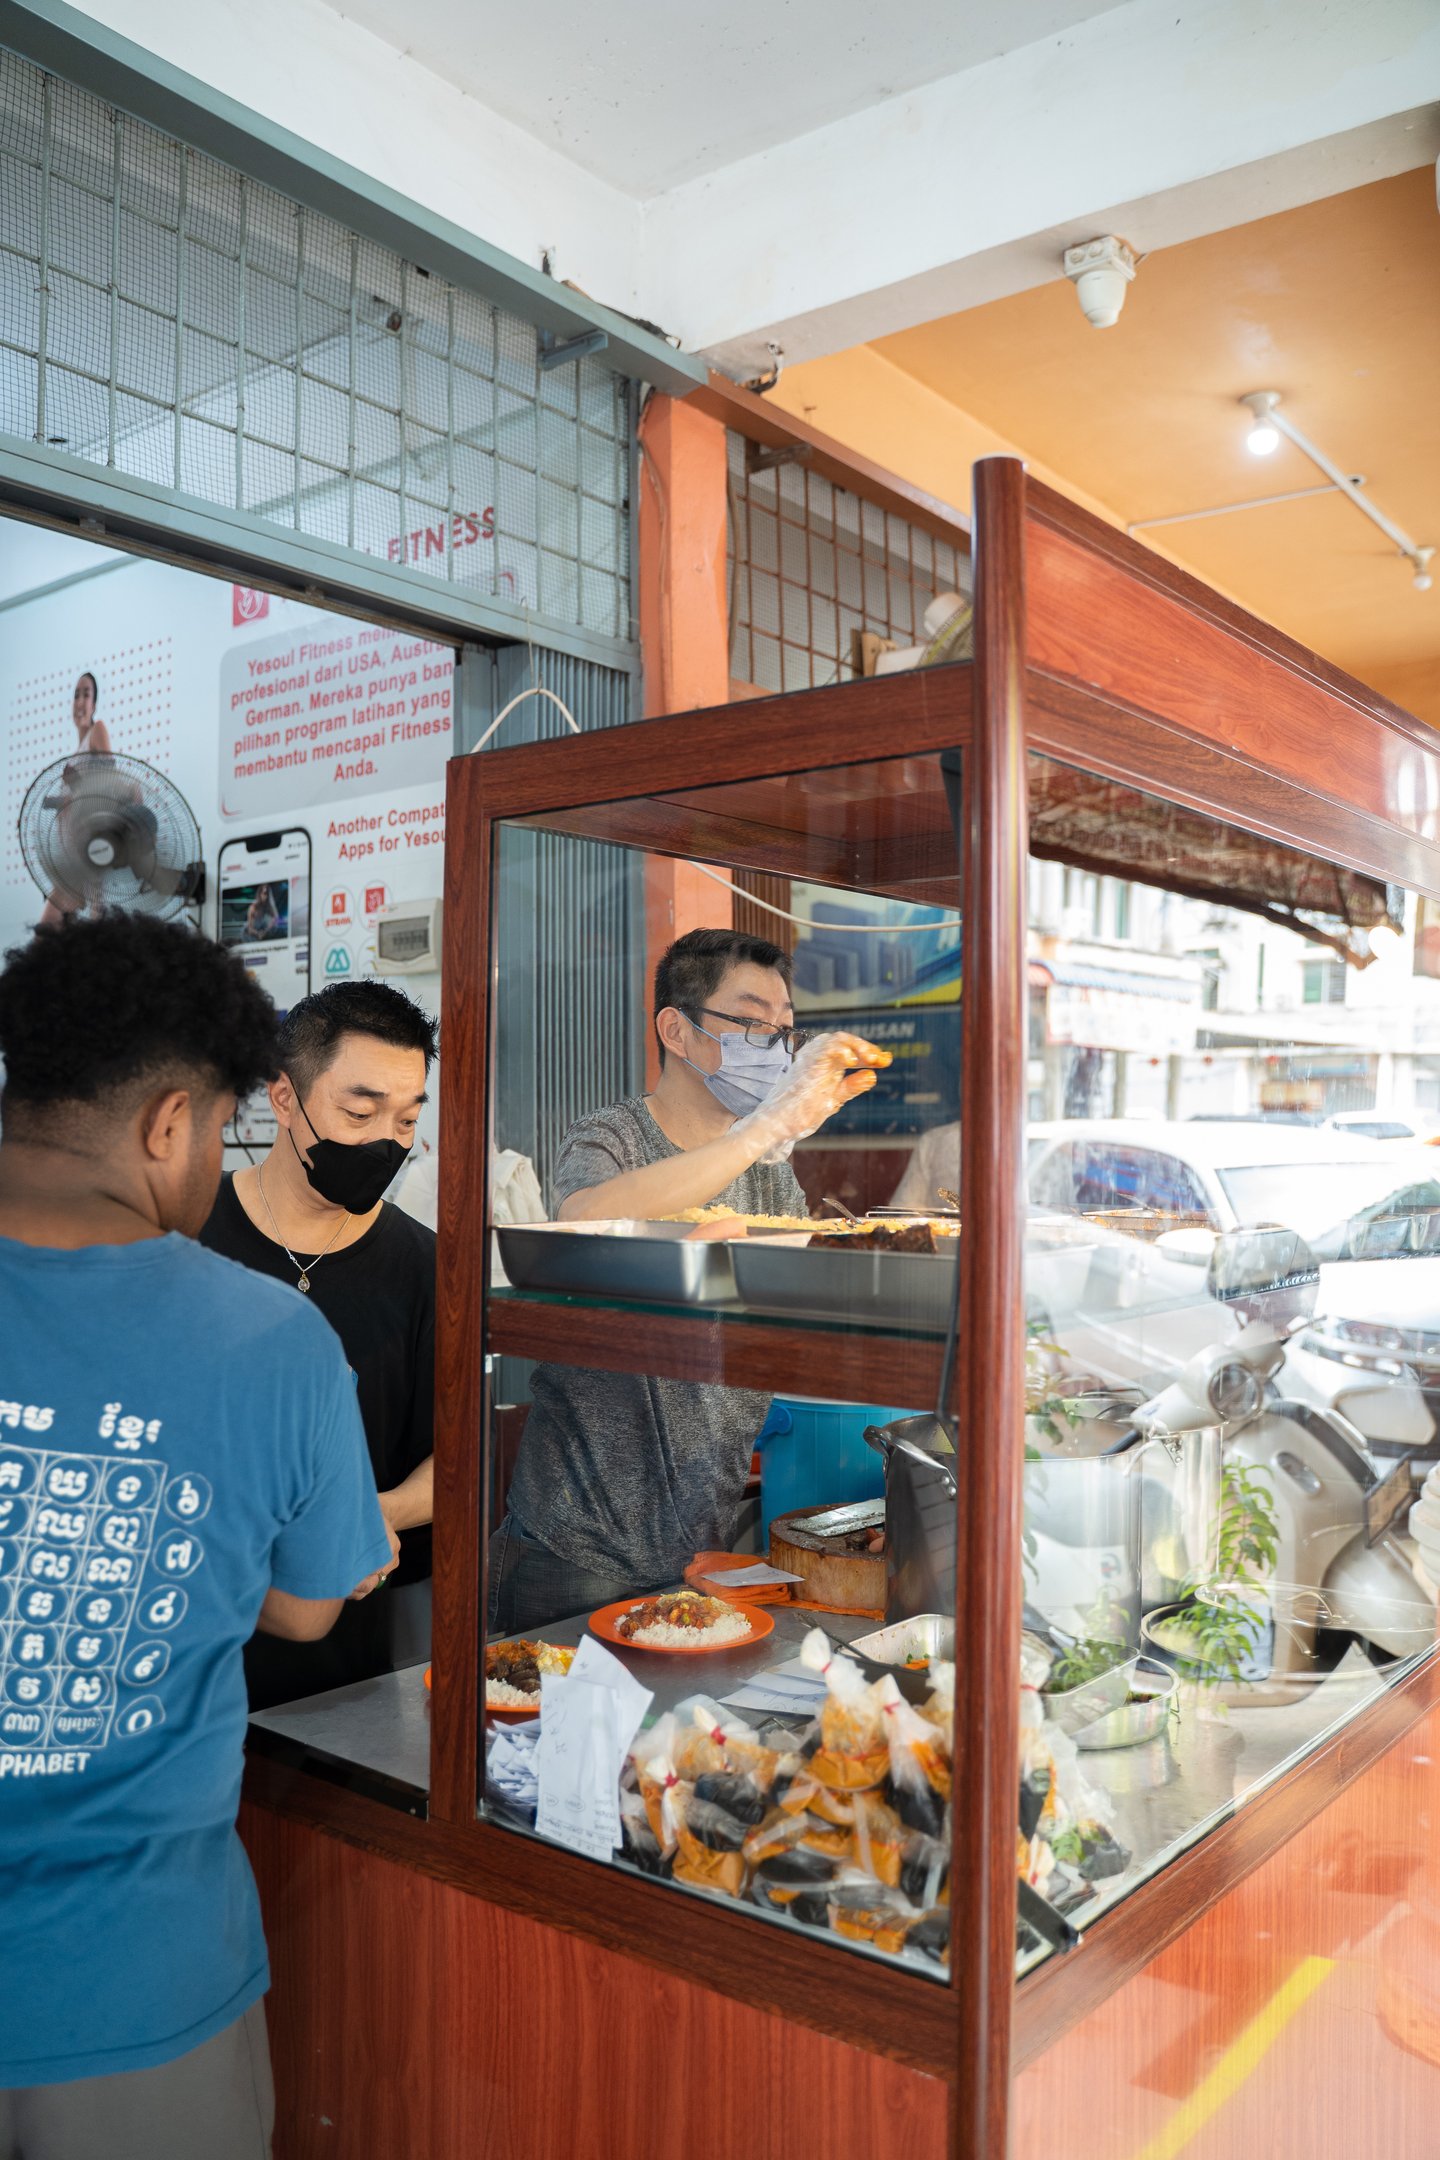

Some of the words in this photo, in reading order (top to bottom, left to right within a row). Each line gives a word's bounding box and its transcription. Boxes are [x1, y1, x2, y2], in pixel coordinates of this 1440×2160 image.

[388, 506, 494, 564] FITNESS
[231, 674, 309, 710] profesional
[314, 661, 342, 683] dari
[348, 651, 386, 674] USA,
[247, 648, 295, 678] Yesoul
[300, 636, 353, 664] Fitness
[234, 730, 280, 758] pilihan
[285, 714, 347, 744] program
[352, 699, 405, 725] latihan
[411, 689, 451, 716] yang
[245, 702, 304, 727] German.
[309, 685, 363, 710] Mereka
[368, 672, 417, 698] punya
[234, 750, 307, 779] membantu
[312, 728, 386, 761] mencapai
[391, 717, 451, 744] Fitness
[334, 759, 378, 782] Anda.
[327, 816, 383, 838] Another
[338, 841, 374, 862] Apps
[379, 834, 400, 853] for
